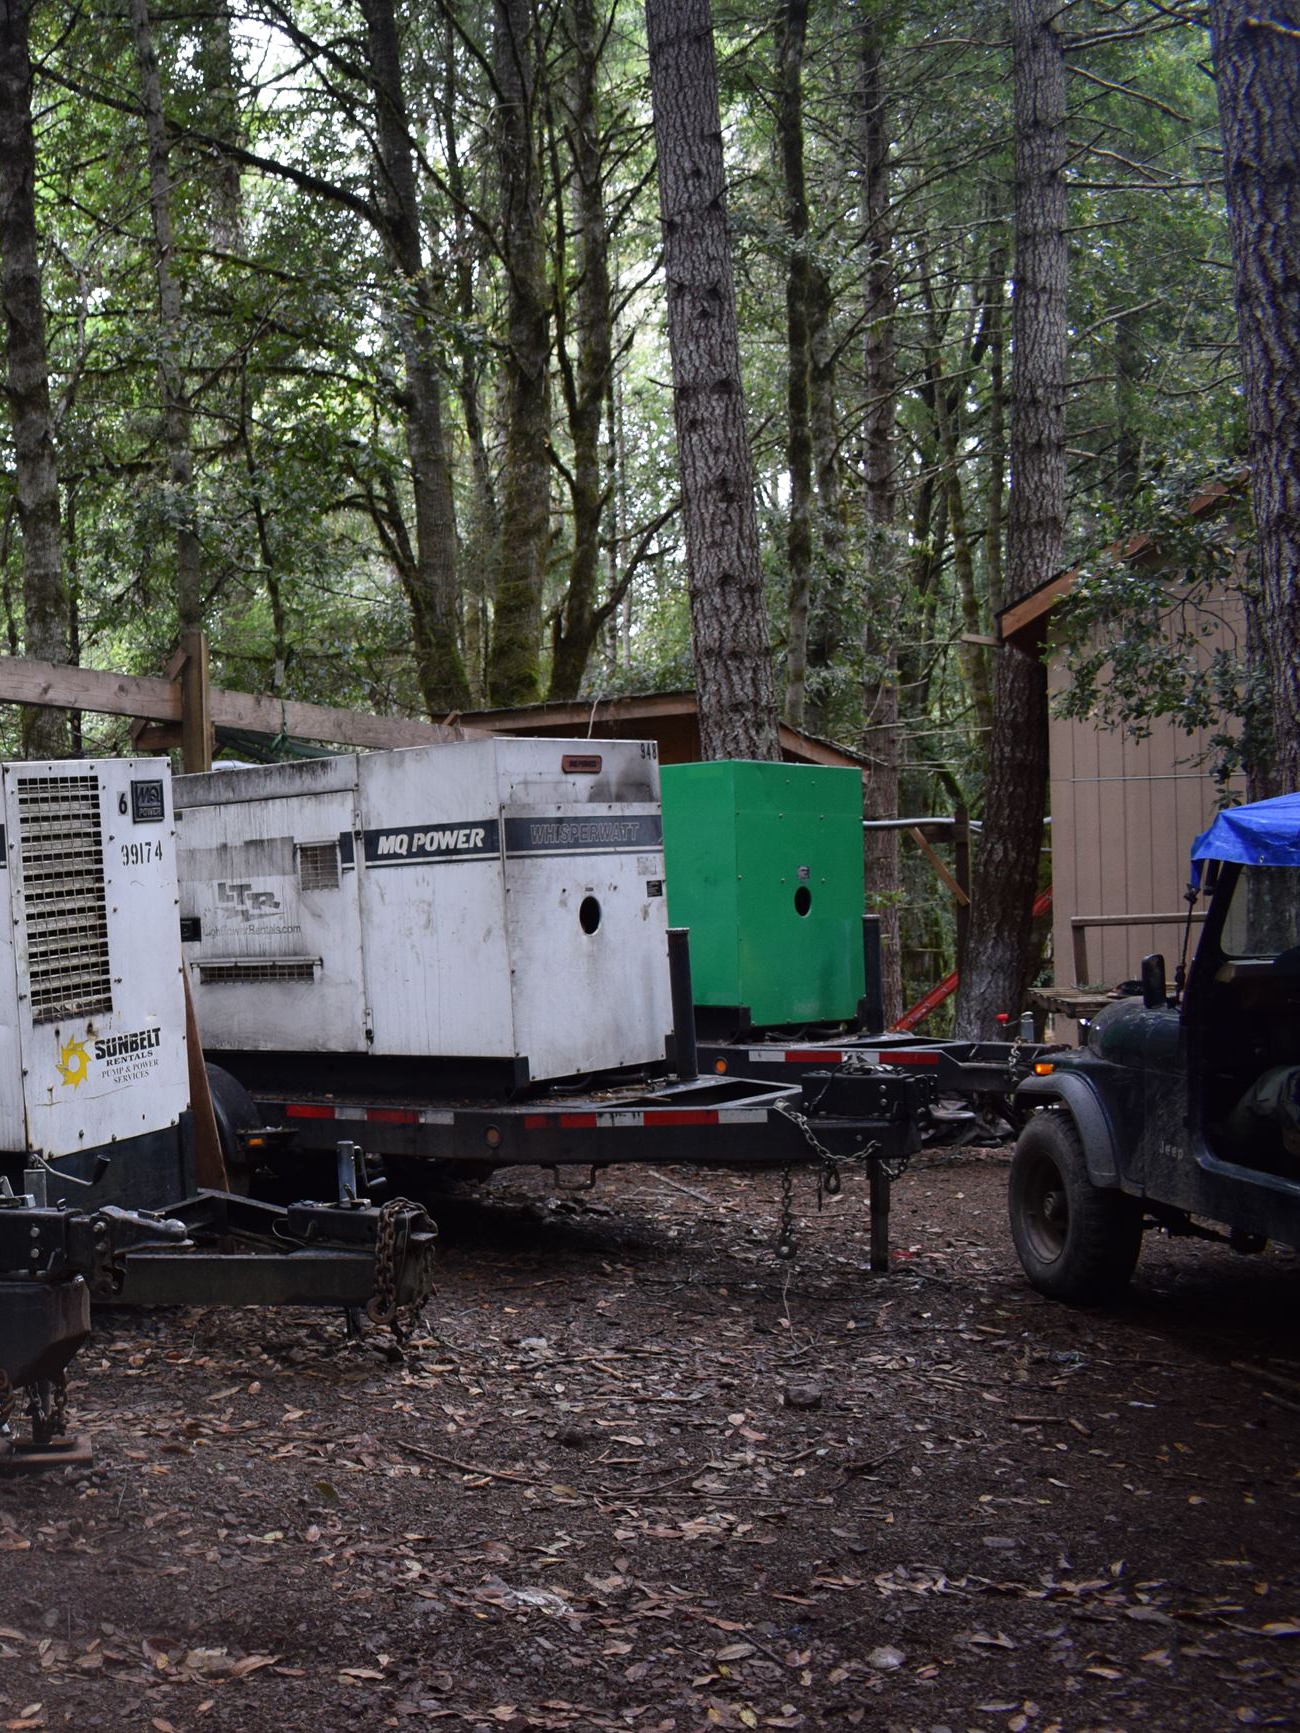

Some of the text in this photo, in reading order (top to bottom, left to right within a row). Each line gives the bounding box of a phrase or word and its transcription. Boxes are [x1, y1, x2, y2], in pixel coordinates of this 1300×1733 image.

[118, 792, 128, 815] 6
[377, 828, 485, 855] MQ POWER
[530, 822, 640, 844] WHISPERWATT
[121, 840, 163, 866] 99174
[94, 1027, 161, 1060] SUNBELT
[102, 1066, 125, 1078] PUMP
[133, 1059, 159, 1070] POWER
[106, 1050, 153, 1067] RENTALS
[113, 1071, 150, 1084] SERVICES
